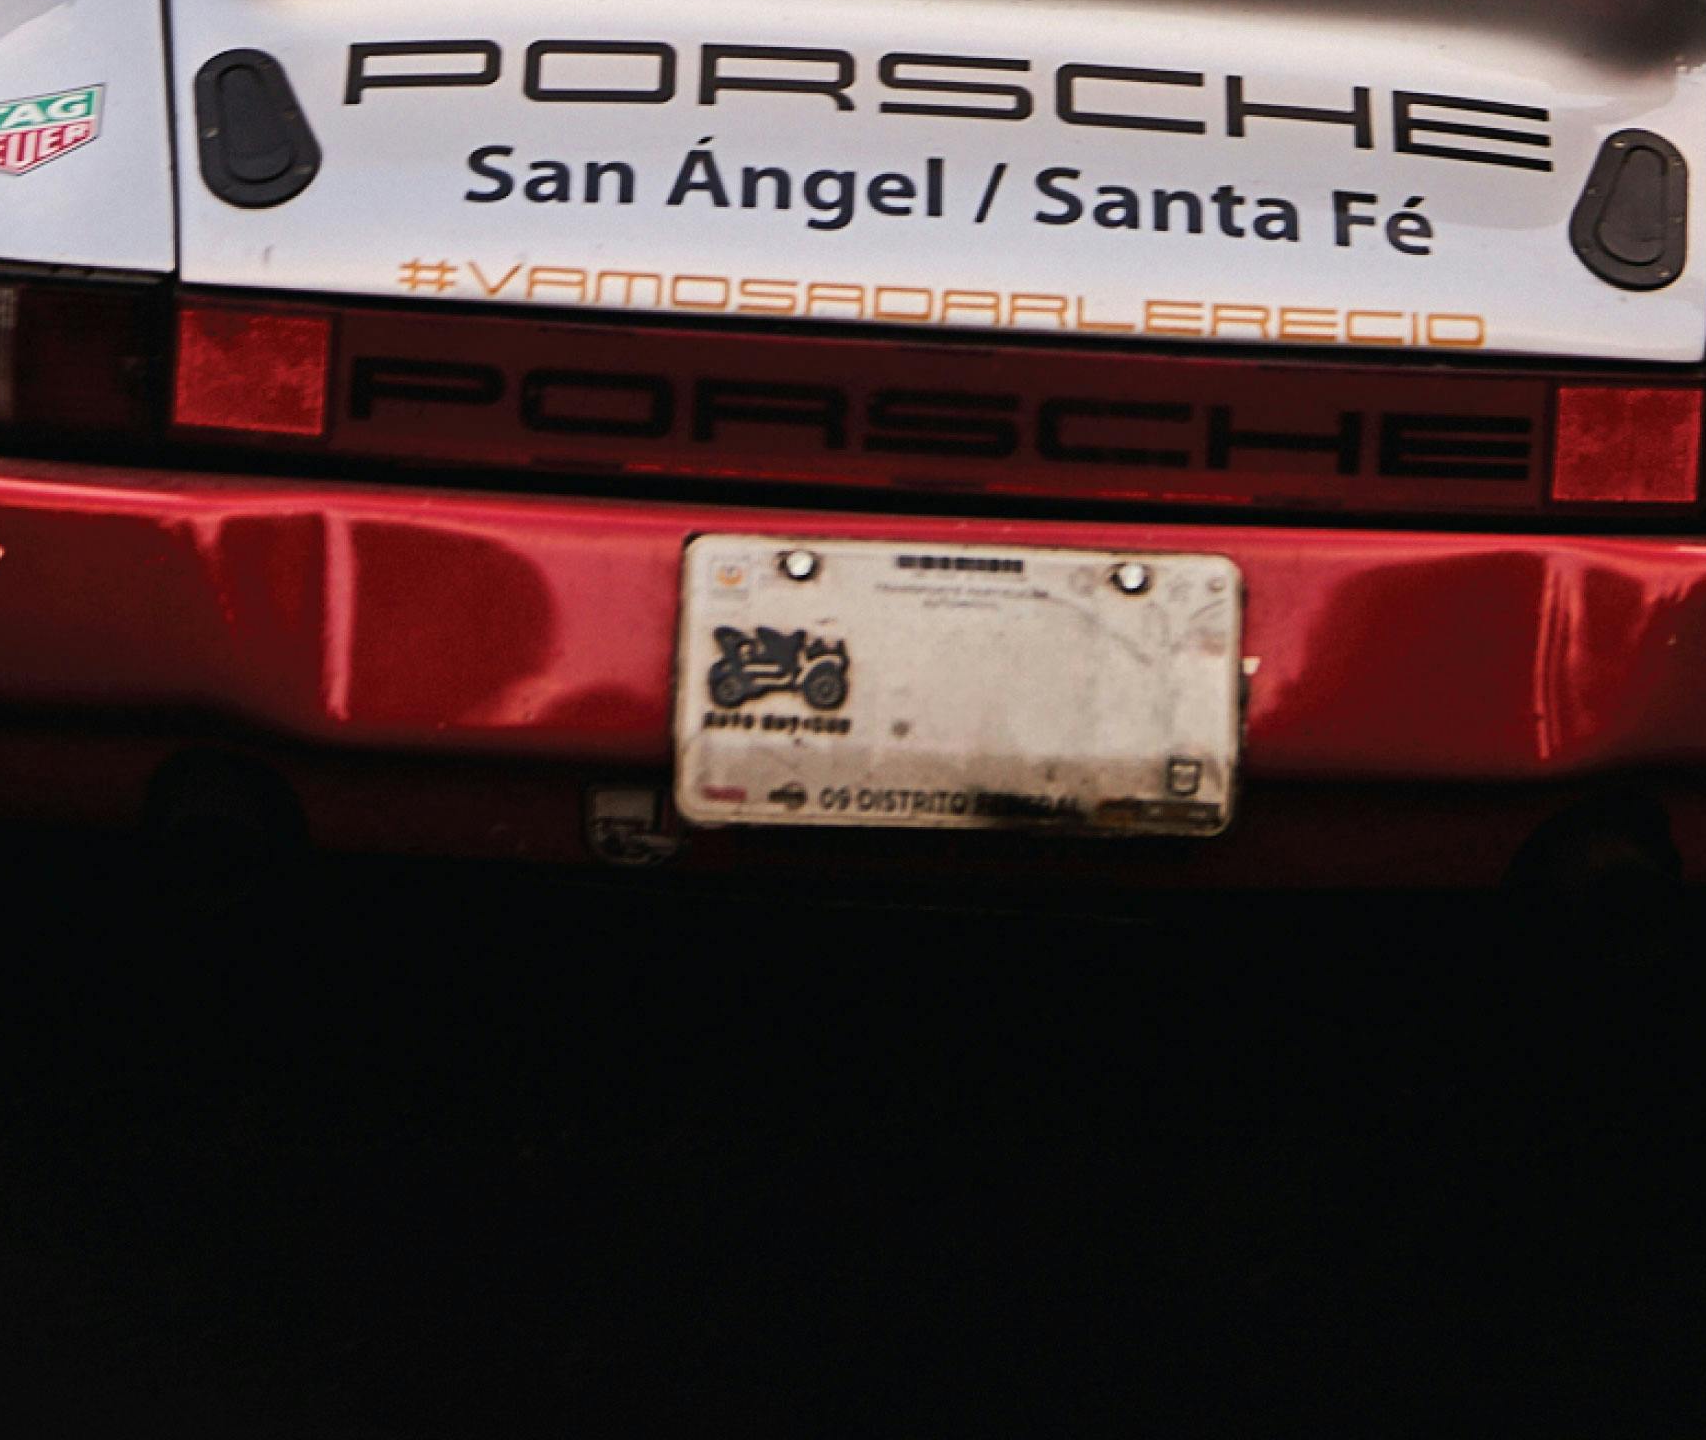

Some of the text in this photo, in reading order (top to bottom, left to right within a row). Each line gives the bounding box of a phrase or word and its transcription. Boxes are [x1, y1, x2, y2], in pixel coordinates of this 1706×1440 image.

[343, 39, 1554, 172] PORSCHE
[463, 136, 1433, 255] San Ángel / Santa Fé
[347, 359, 1533, 481] PORSCHE
[819, 786, 852, 811] 09
[857, 788, 969, 815] DISTRITO
